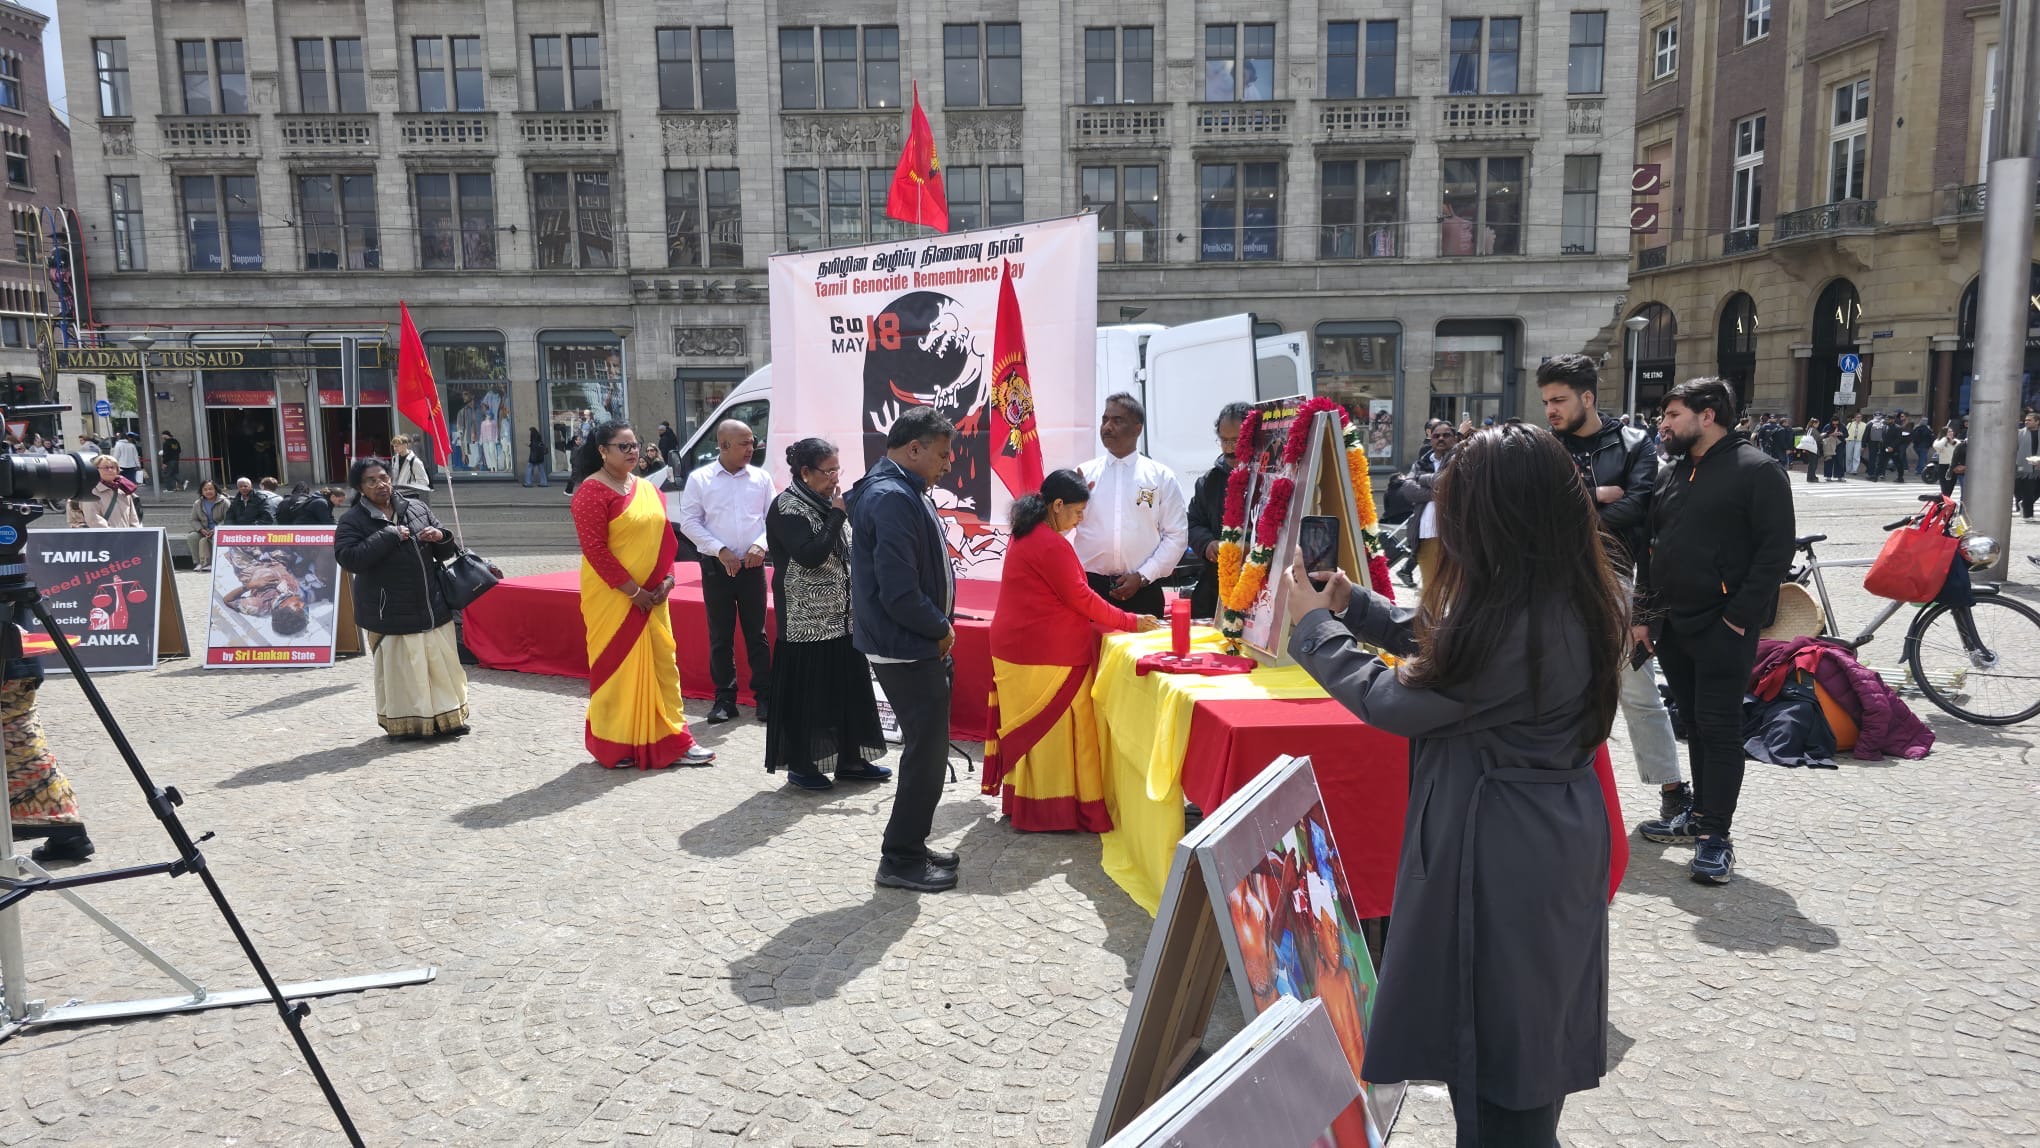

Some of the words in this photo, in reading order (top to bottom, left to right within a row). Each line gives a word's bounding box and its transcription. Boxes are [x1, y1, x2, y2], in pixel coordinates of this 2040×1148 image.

[987, 233, 1025, 261] நாள்
[815, 279, 847, 298] Tamil
[853, 274, 909, 295] Genocide
[913, 264, 998, 289] Remembrance
[1008, 261, 1025, 279] ay
[866, 312, 902, 352] 18
[832, 337, 865, 354] MAY
[159, 351, 244, 367] TUSSAUD
[222, 534, 251, 543] Justice
[252, 534, 266, 543] For
[267, 532, 294, 543] Tamil
[295, 534, 334, 543] Genocide
[41, 550, 110, 563] TAMILS
[40, 575, 82, 598] need
[84, 555, 142, 585] justice
[222, 651, 233, 662] by
[235, 650, 250, 661] Sri
[252, 649, 290, 661] Lankan
[291, 650, 316, 661] State
